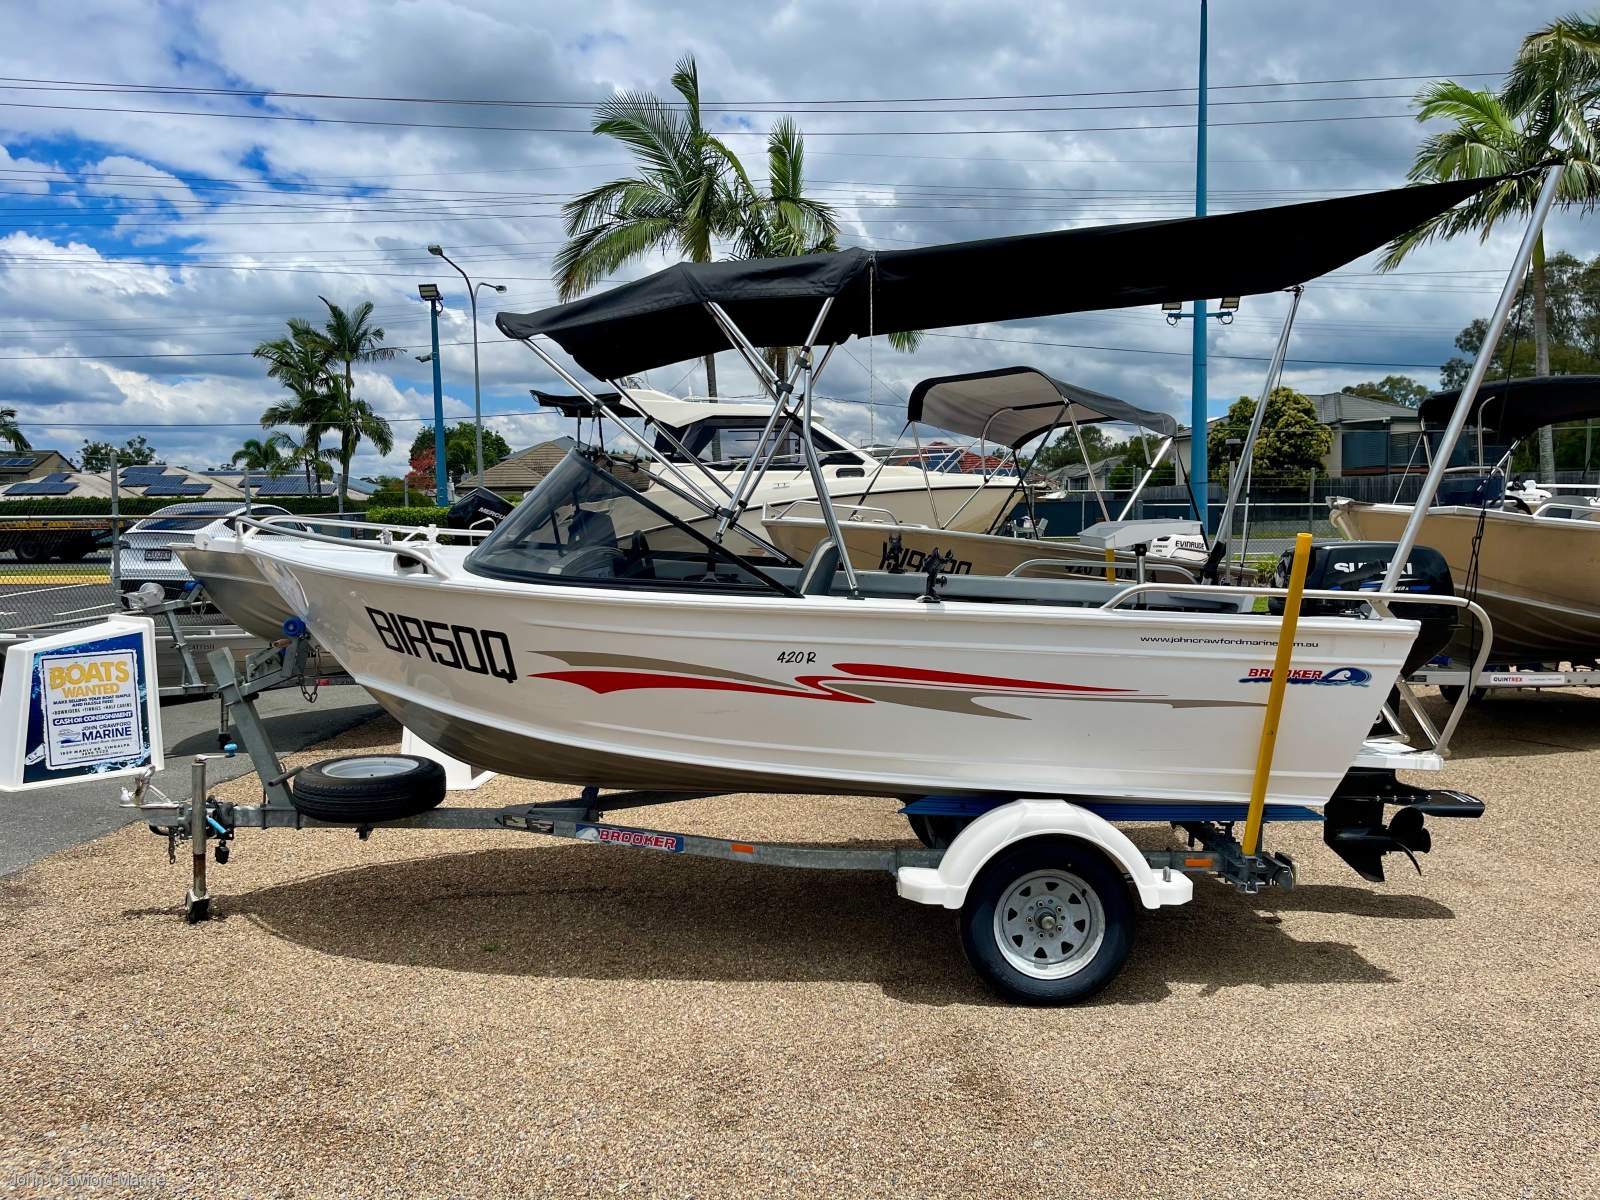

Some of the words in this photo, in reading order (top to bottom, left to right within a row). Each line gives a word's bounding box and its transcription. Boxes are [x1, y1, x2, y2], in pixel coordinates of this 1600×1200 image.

[479, 507, 506, 519] MERCU
[1175, 540, 1205, 550] EVINRUDE
[1140, 636, 1319, 648] www.johncrawfordmarinem.au
[776, 651, 805, 664] 420
[806, 651, 817, 664] R
[48, 661, 130, 689] BOATS
[1248, 668, 1323, 680] BRKER
[62, 683, 120, 698] WANTED
[83, 711, 132, 721] CONSIGNMENT
[98, 721, 132, 729] CRAWFORD
[82, 727, 132, 741] MARINE
[600, 829, 677, 849] BROOKER
